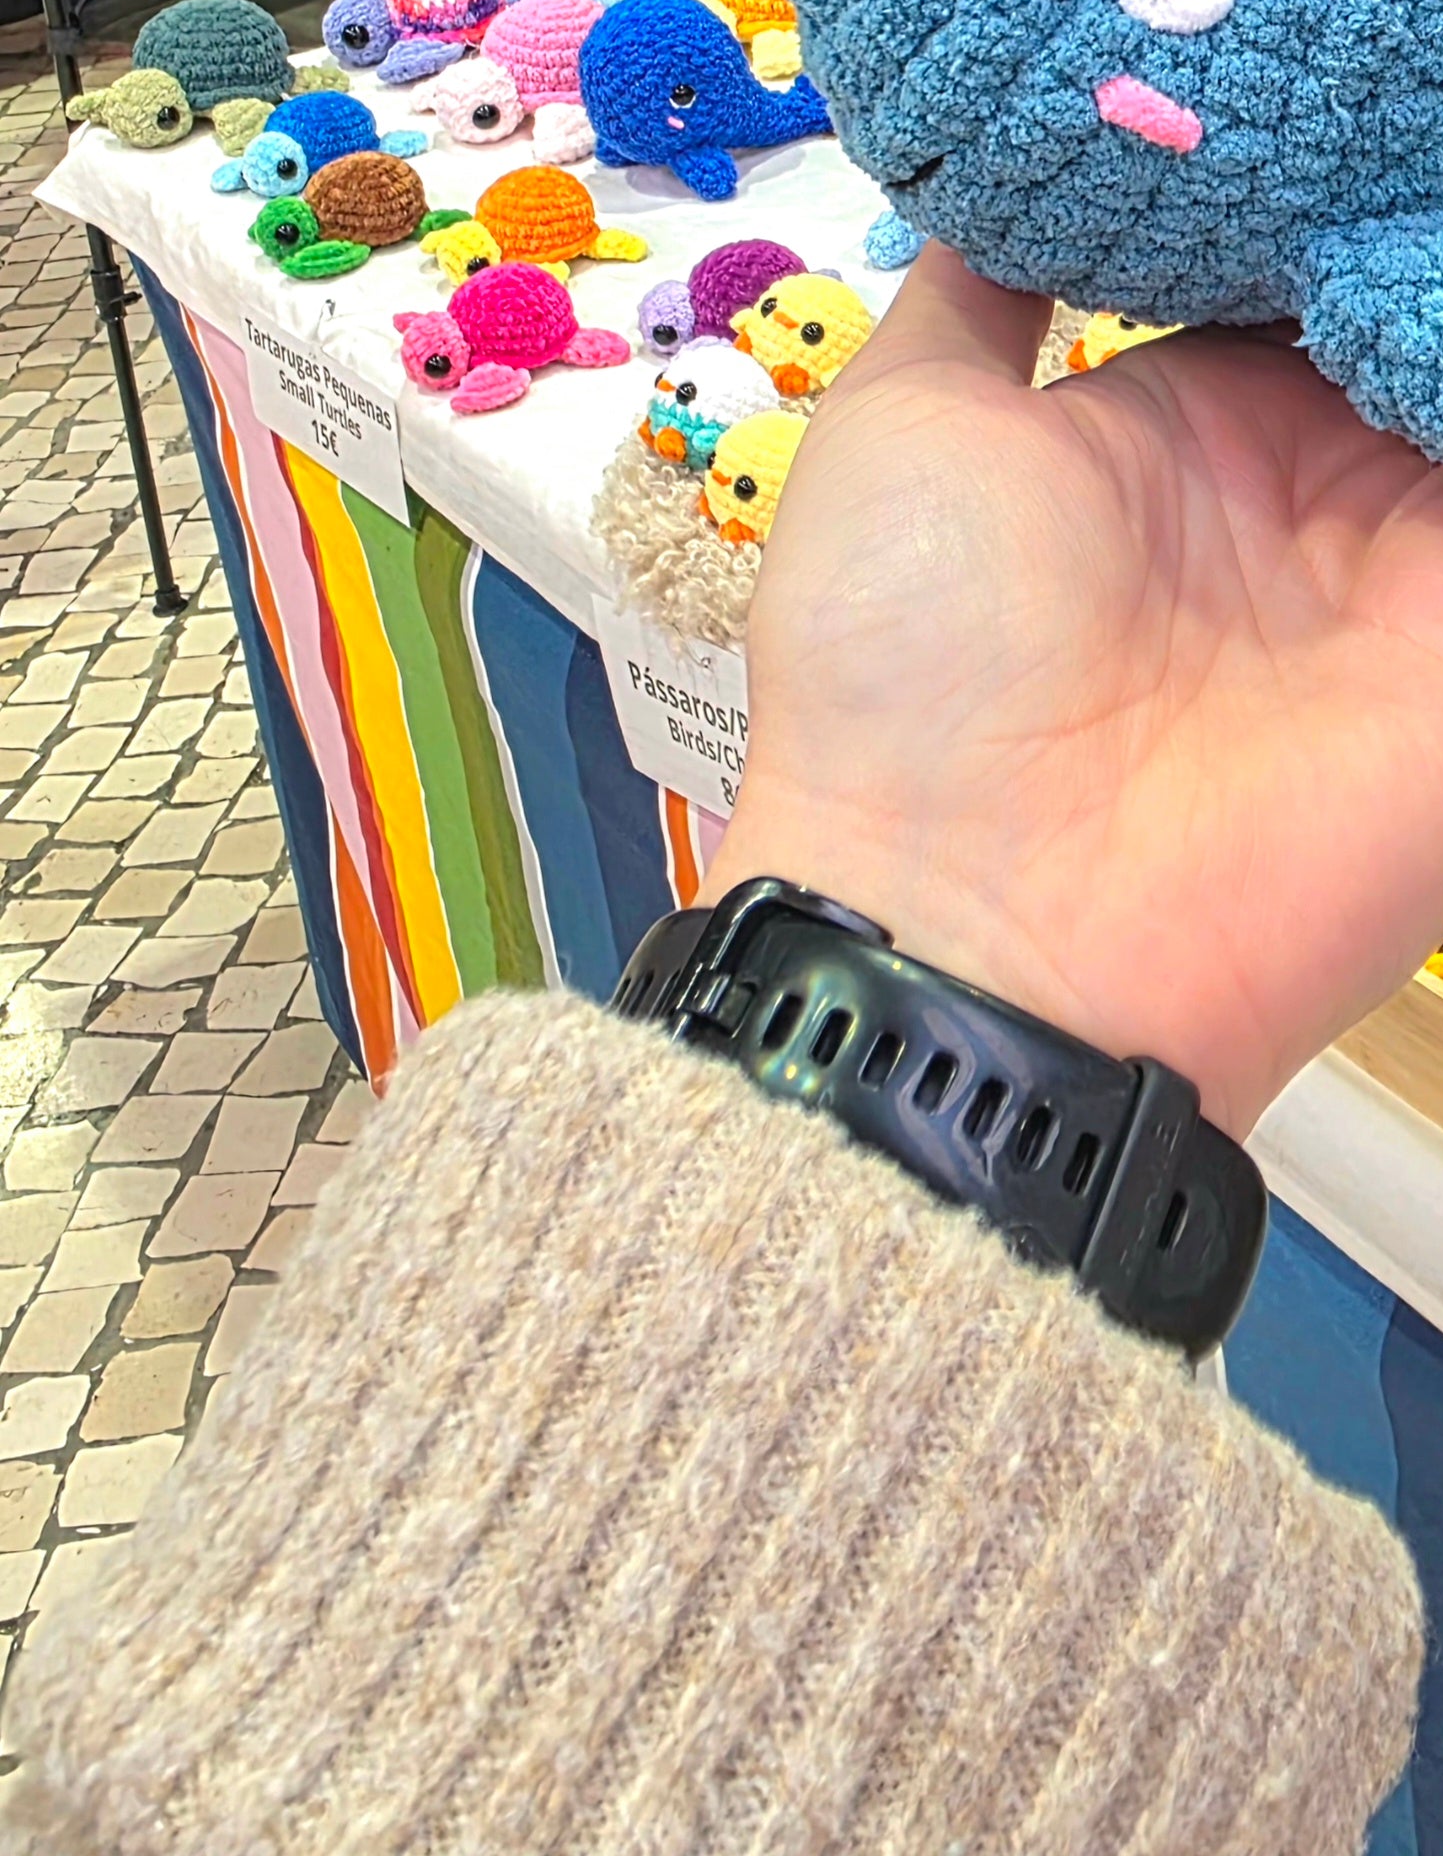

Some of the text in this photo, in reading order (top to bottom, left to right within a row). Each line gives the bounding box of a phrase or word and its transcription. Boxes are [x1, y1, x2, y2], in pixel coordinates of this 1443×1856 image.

[244, 317, 392, 431] Tartarugas Pequenas
[279, 370, 362, 440] Small Turtles
[311, 419, 339, 457] 15€
[720, 776, 740, 807] 8
